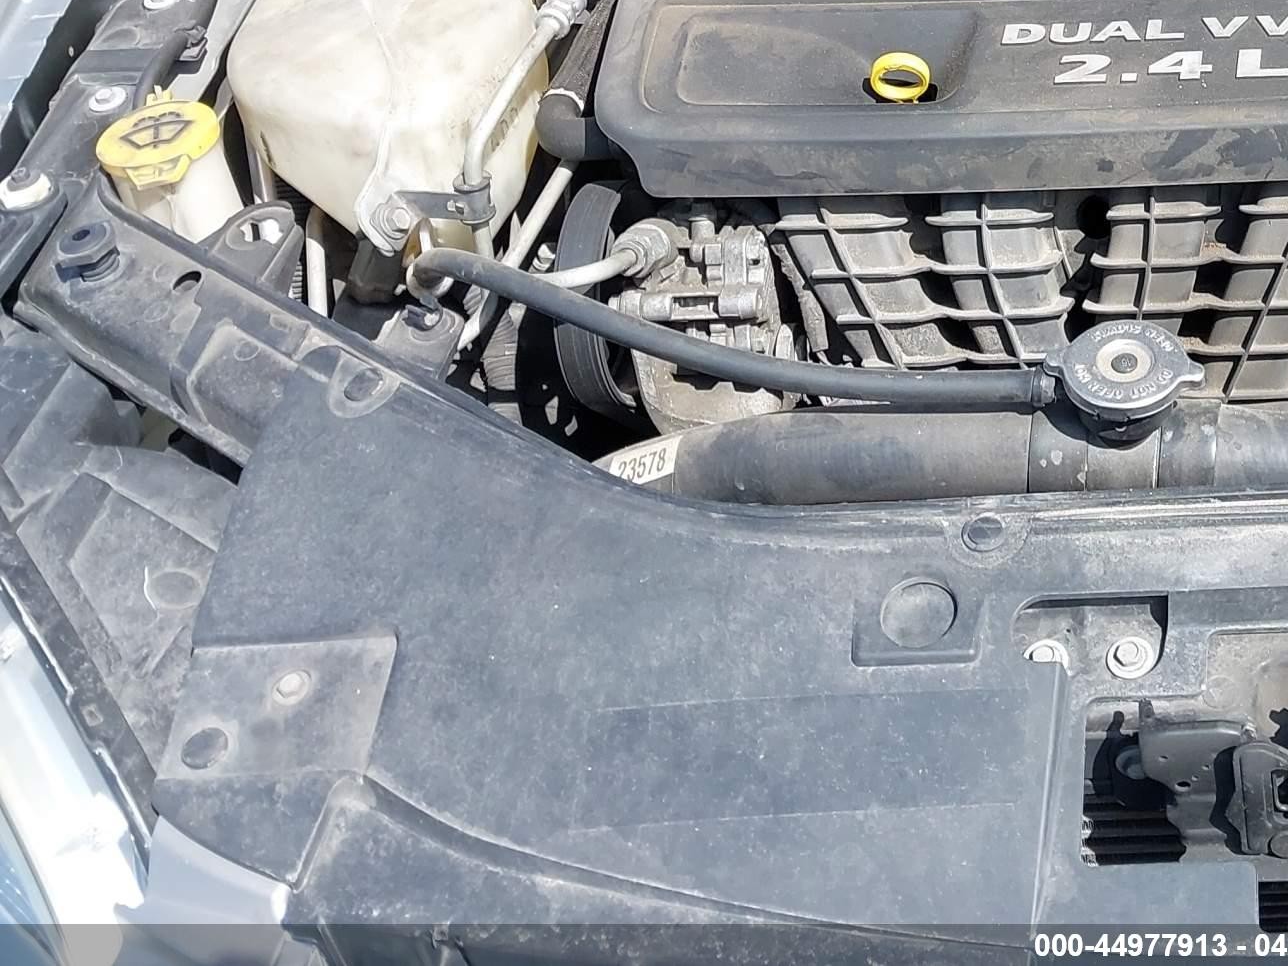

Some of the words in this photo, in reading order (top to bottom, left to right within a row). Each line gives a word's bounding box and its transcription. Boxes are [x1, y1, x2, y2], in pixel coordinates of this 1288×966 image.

[1001, 19, 1184, 45] DUAL
[1053, 50, 1213, 84] 2.4
[1088, 381, 1124, 400] OPEN
[1130, 381, 1157, 400] NOT
[618, 447, 667, 482] 23578
